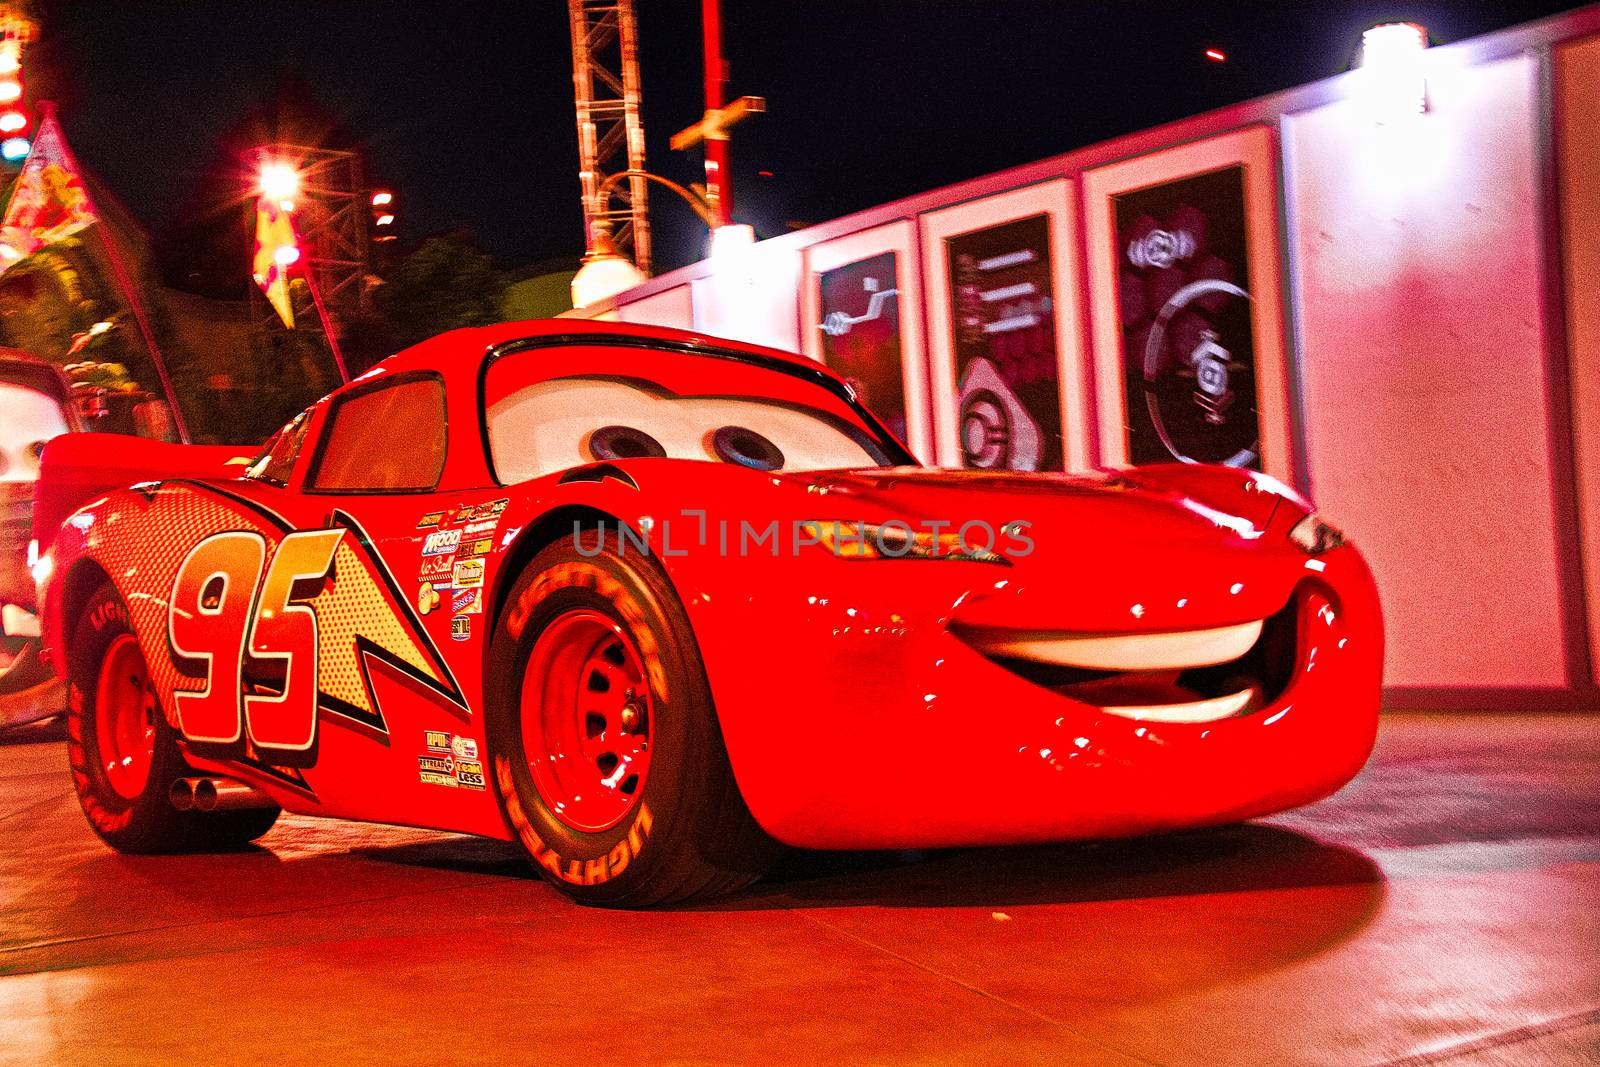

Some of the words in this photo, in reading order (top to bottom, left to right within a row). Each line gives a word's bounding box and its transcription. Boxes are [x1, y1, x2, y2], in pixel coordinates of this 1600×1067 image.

[423, 531, 461, 554] MOOD
[433, 555, 455, 574] Stall
[169, 528, 347, 751] 95
[507, 561, 670, 703] LIGHTYEAR
[427, 733, 446, 747] RPM
[420, 759, 445, 768] RETREAD
[459, 773, 483, 784] Less
[495, 754, 653, 886] LIGHTYEAR
